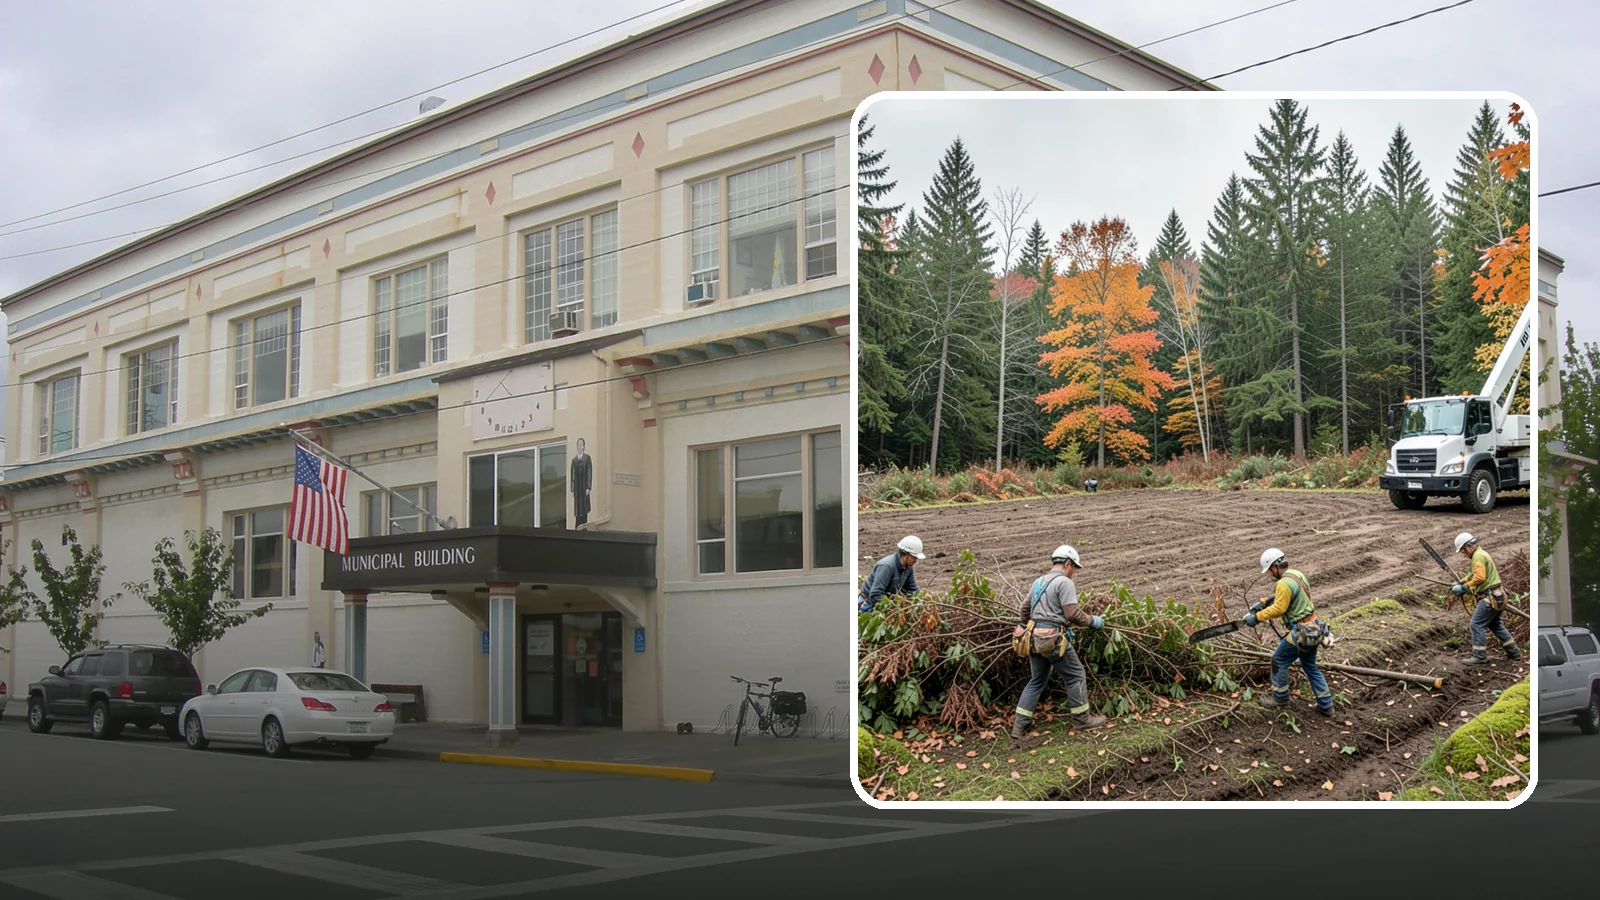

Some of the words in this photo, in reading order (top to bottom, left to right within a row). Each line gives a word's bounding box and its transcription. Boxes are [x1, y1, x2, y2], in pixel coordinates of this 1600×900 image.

[480, 407, 485, 415] 8
[487, 417, 492, 426] 9
[494, 423, 501, 432] 10
[501, 425, 506, 434] 11
[507, 425, 514, 434] 12
[521, 420, 526, 429] 2
[341, 552, 405, 572] MUNICIPAL
[414, 546, 475, 567] BUILDING
